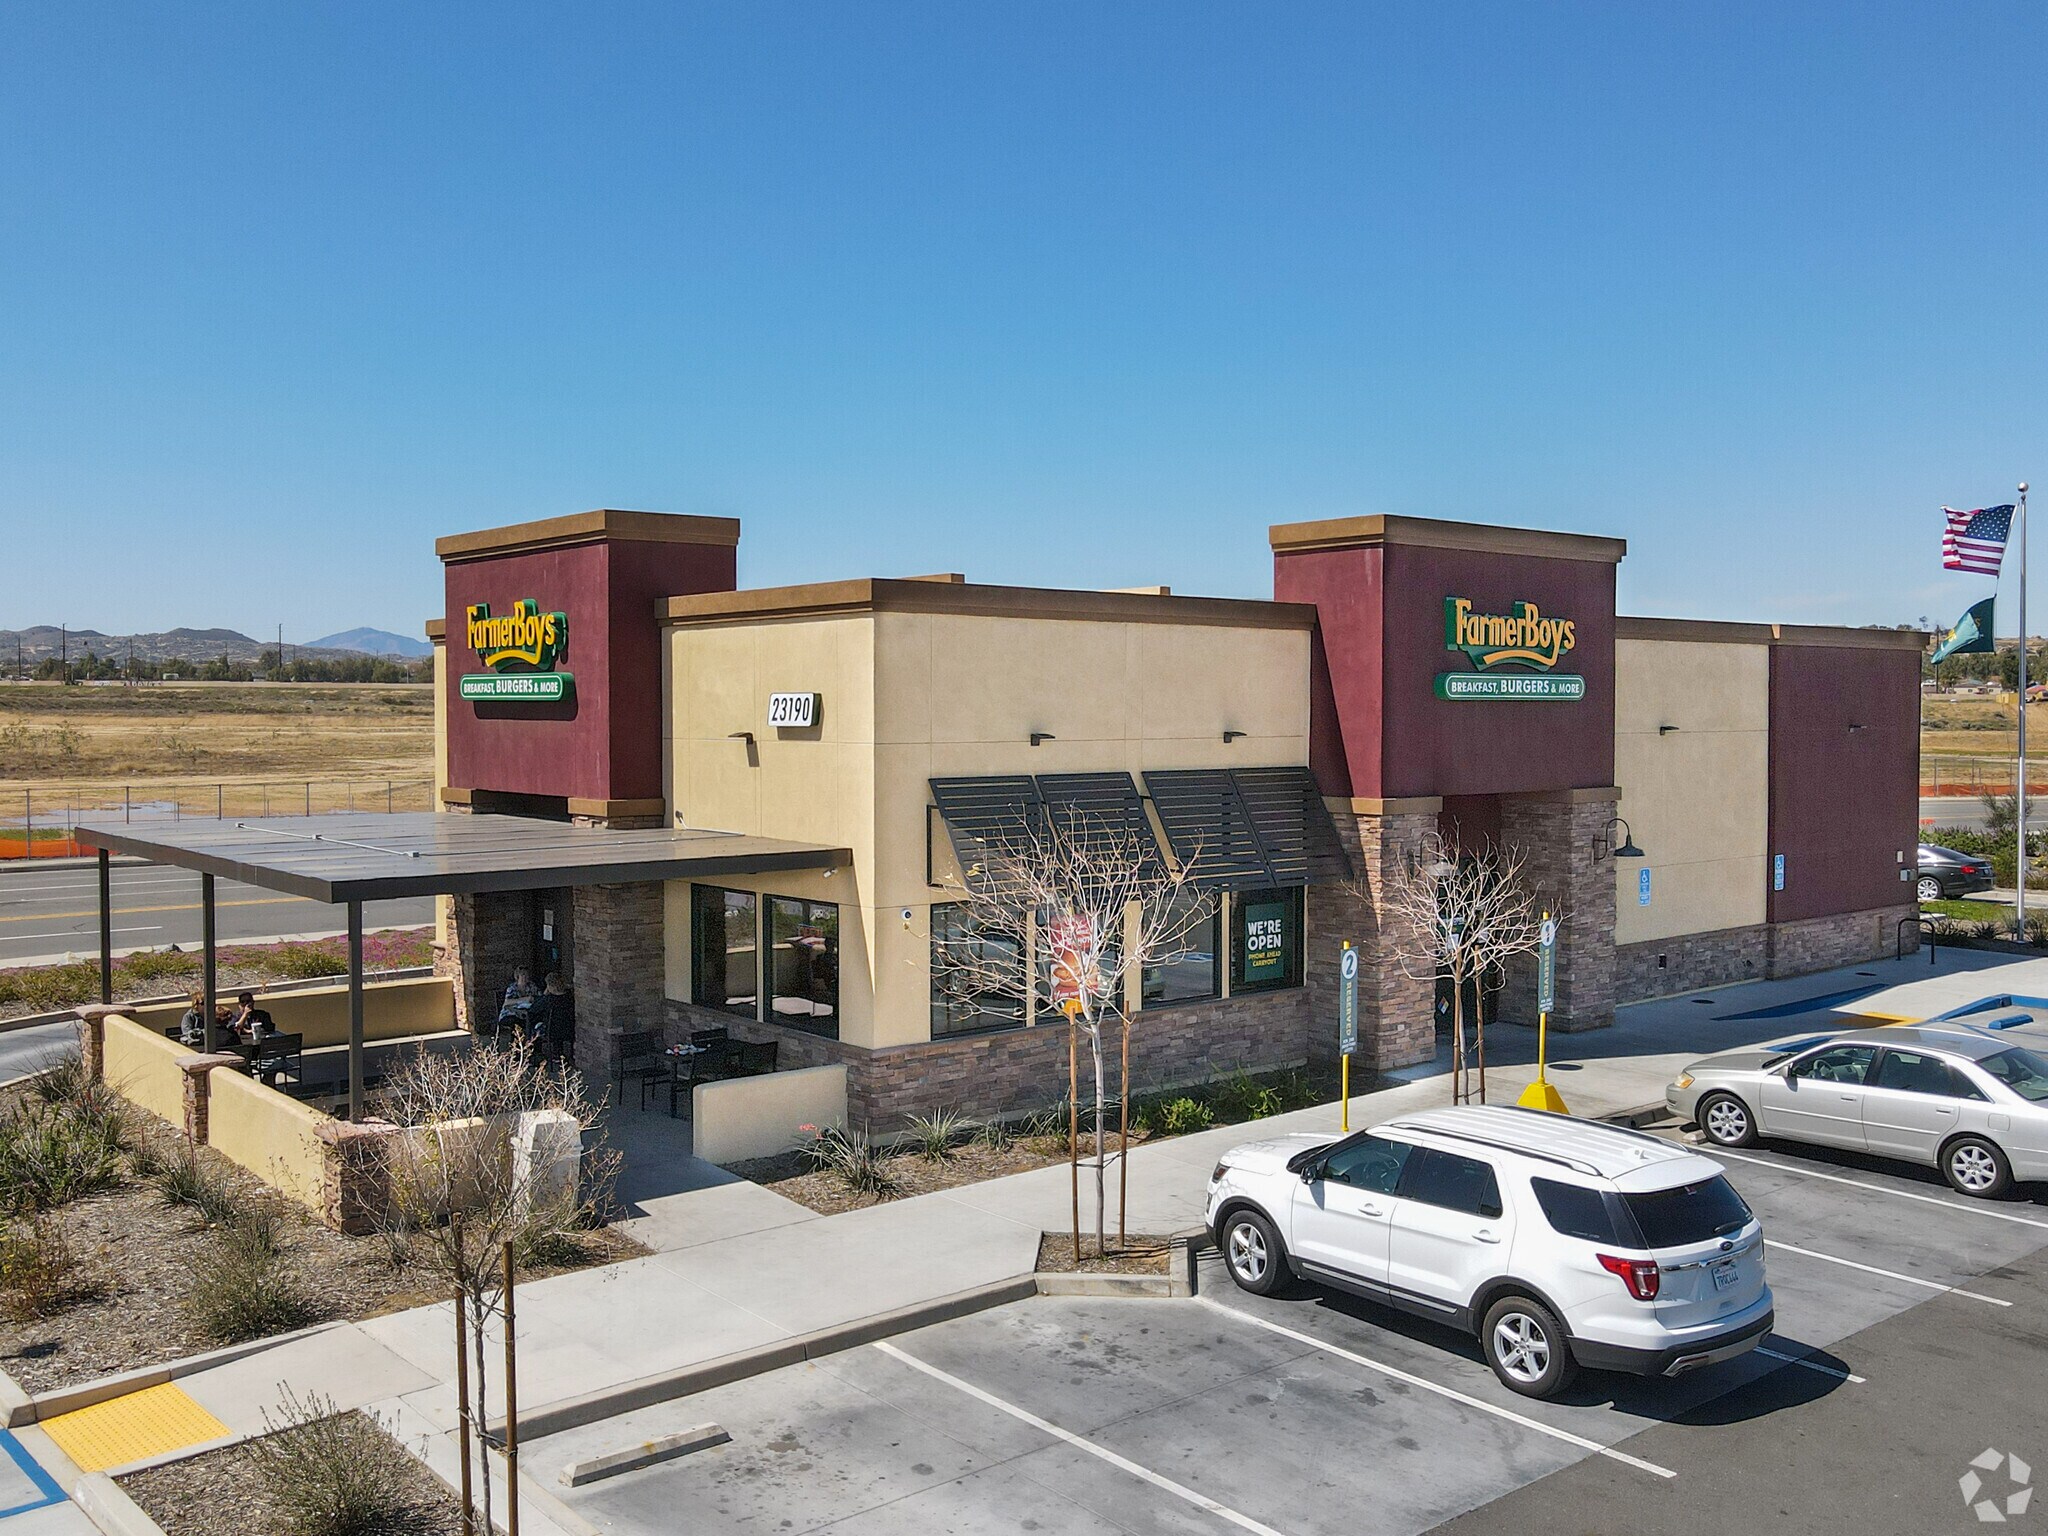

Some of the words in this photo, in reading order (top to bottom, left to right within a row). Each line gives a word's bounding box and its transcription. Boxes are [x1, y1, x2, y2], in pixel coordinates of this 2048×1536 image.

[463, 682, 495, 694] BREAKFAST,
[496, 679, 533, 693] BURGERS
[533, 682, 539, 692] &
[540, 681, 558, 692] MORE
[1451, 681, 1499, 695] BREAKFAST,
[1500, 679, 1550, 694] BURGERS
[1551, 683, 1557, 693] &
[1558, 684, 1580, 694] MORE
[771, 697, 810, 722] 23190
[1248, 919, 1281, 936] WE'RE
[1248, 934, 1281, 951] OPEN
[1346, 954, 1353, 976] 2
